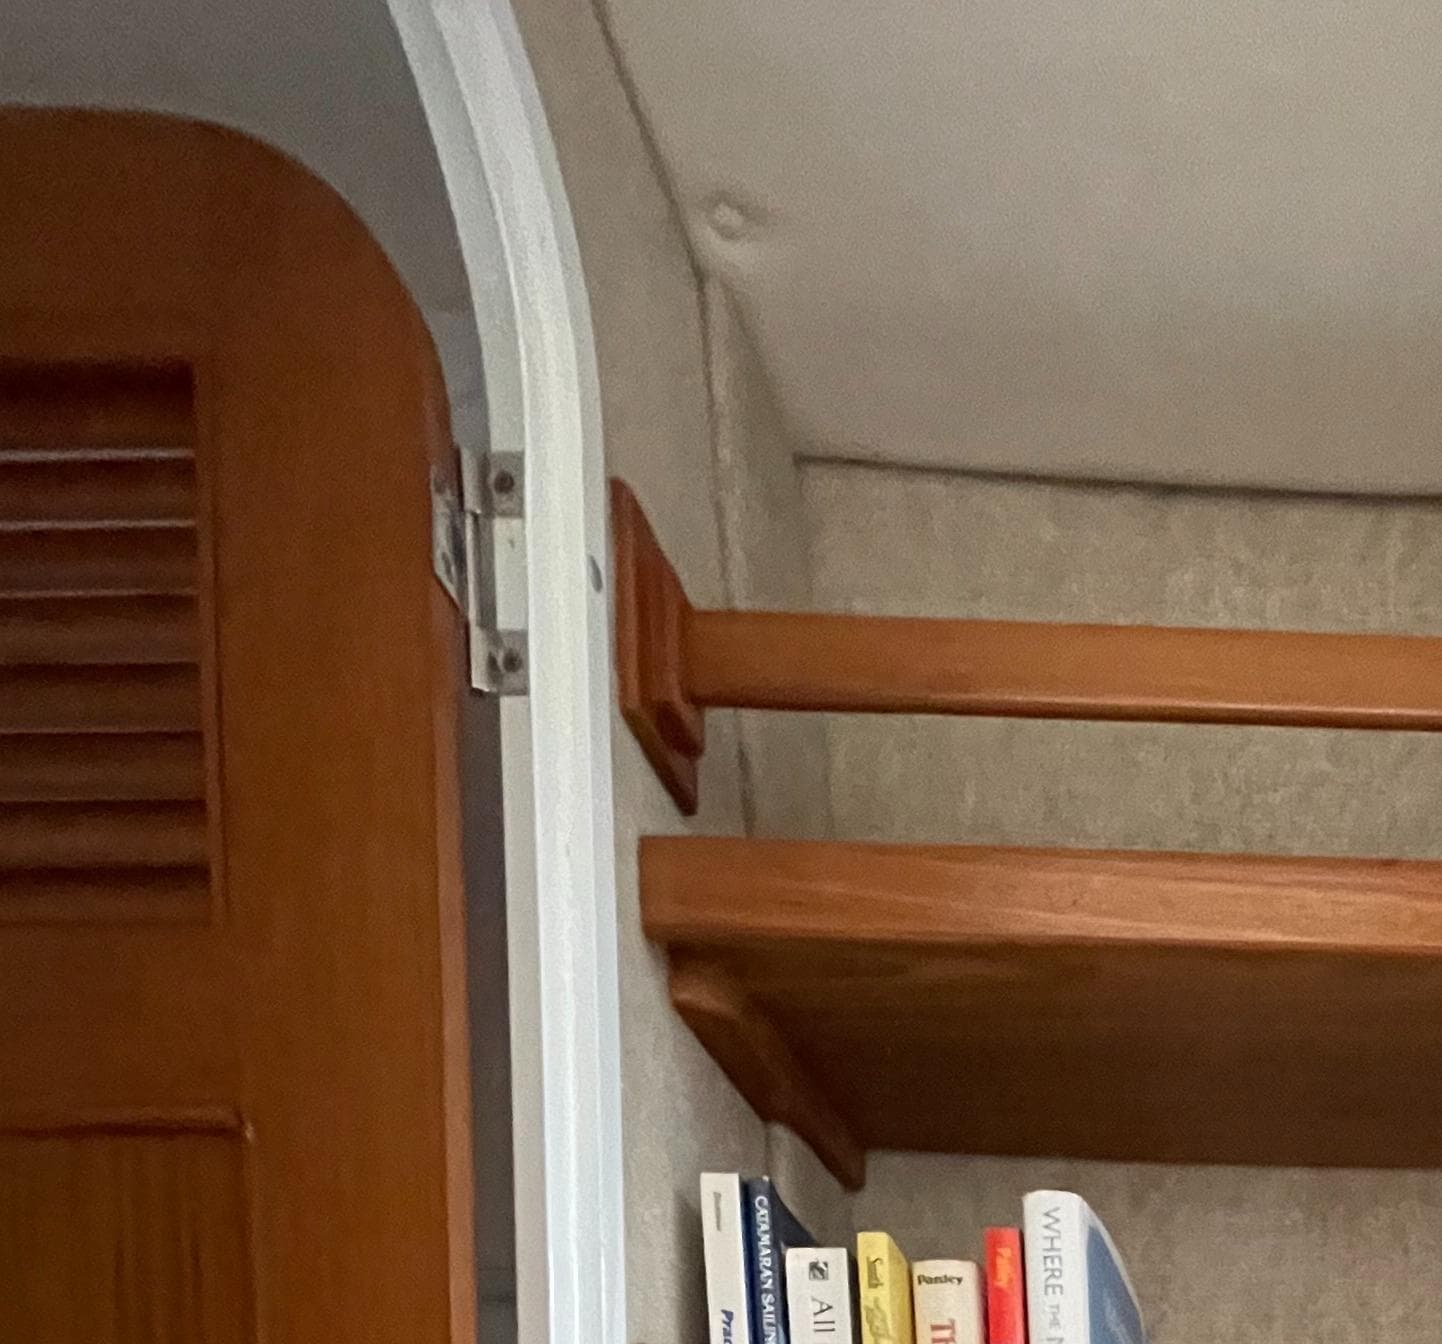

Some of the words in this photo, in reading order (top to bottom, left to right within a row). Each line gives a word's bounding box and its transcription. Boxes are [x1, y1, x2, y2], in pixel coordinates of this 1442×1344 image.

[754, 1195, 775, 1290] CATAMARAN
[1042, 1206, 1064, 1297] WHERE
[811, 1298, 836, 1333] All
[1049, 1302, 1062, 1329] THE
